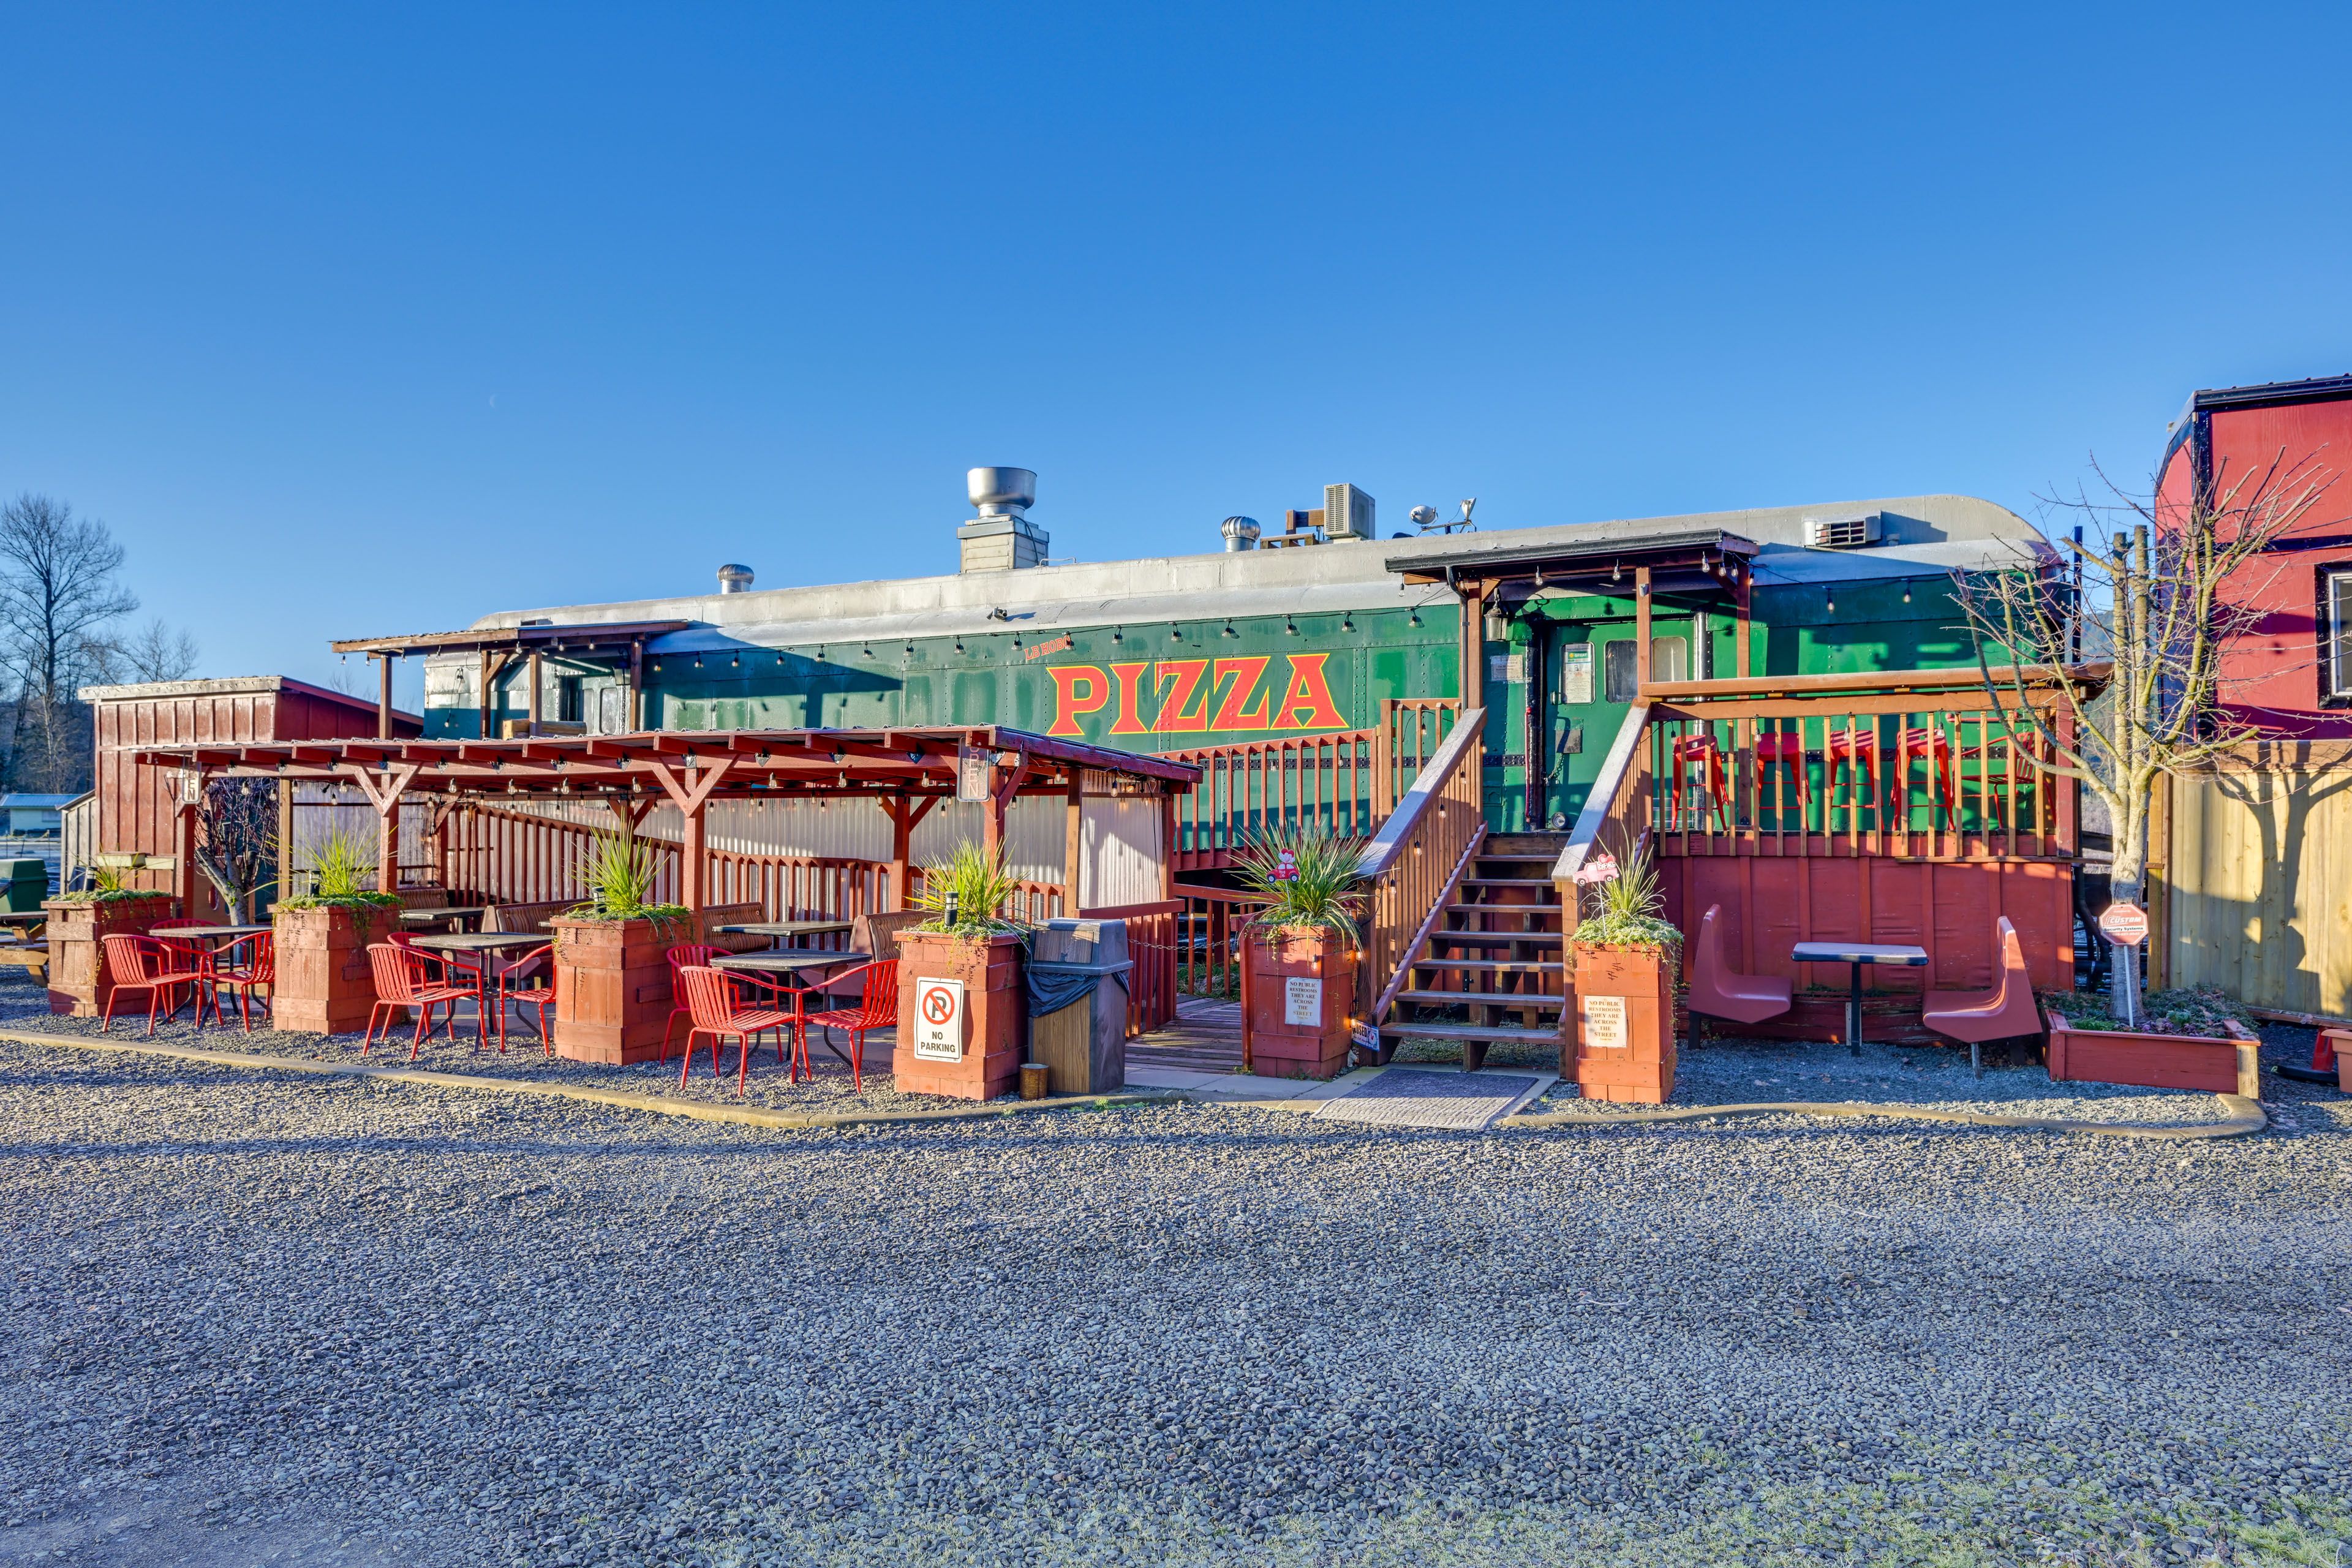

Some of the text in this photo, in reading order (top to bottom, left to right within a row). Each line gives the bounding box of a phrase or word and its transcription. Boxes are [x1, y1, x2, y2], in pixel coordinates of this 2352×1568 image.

[1024, 646, 1040, 660] LB
[1046, 653, 1349, 736] PIZZA
[932, 1031, 943, 1040] NO
[921, 1041, 956, 1052] PARKING
